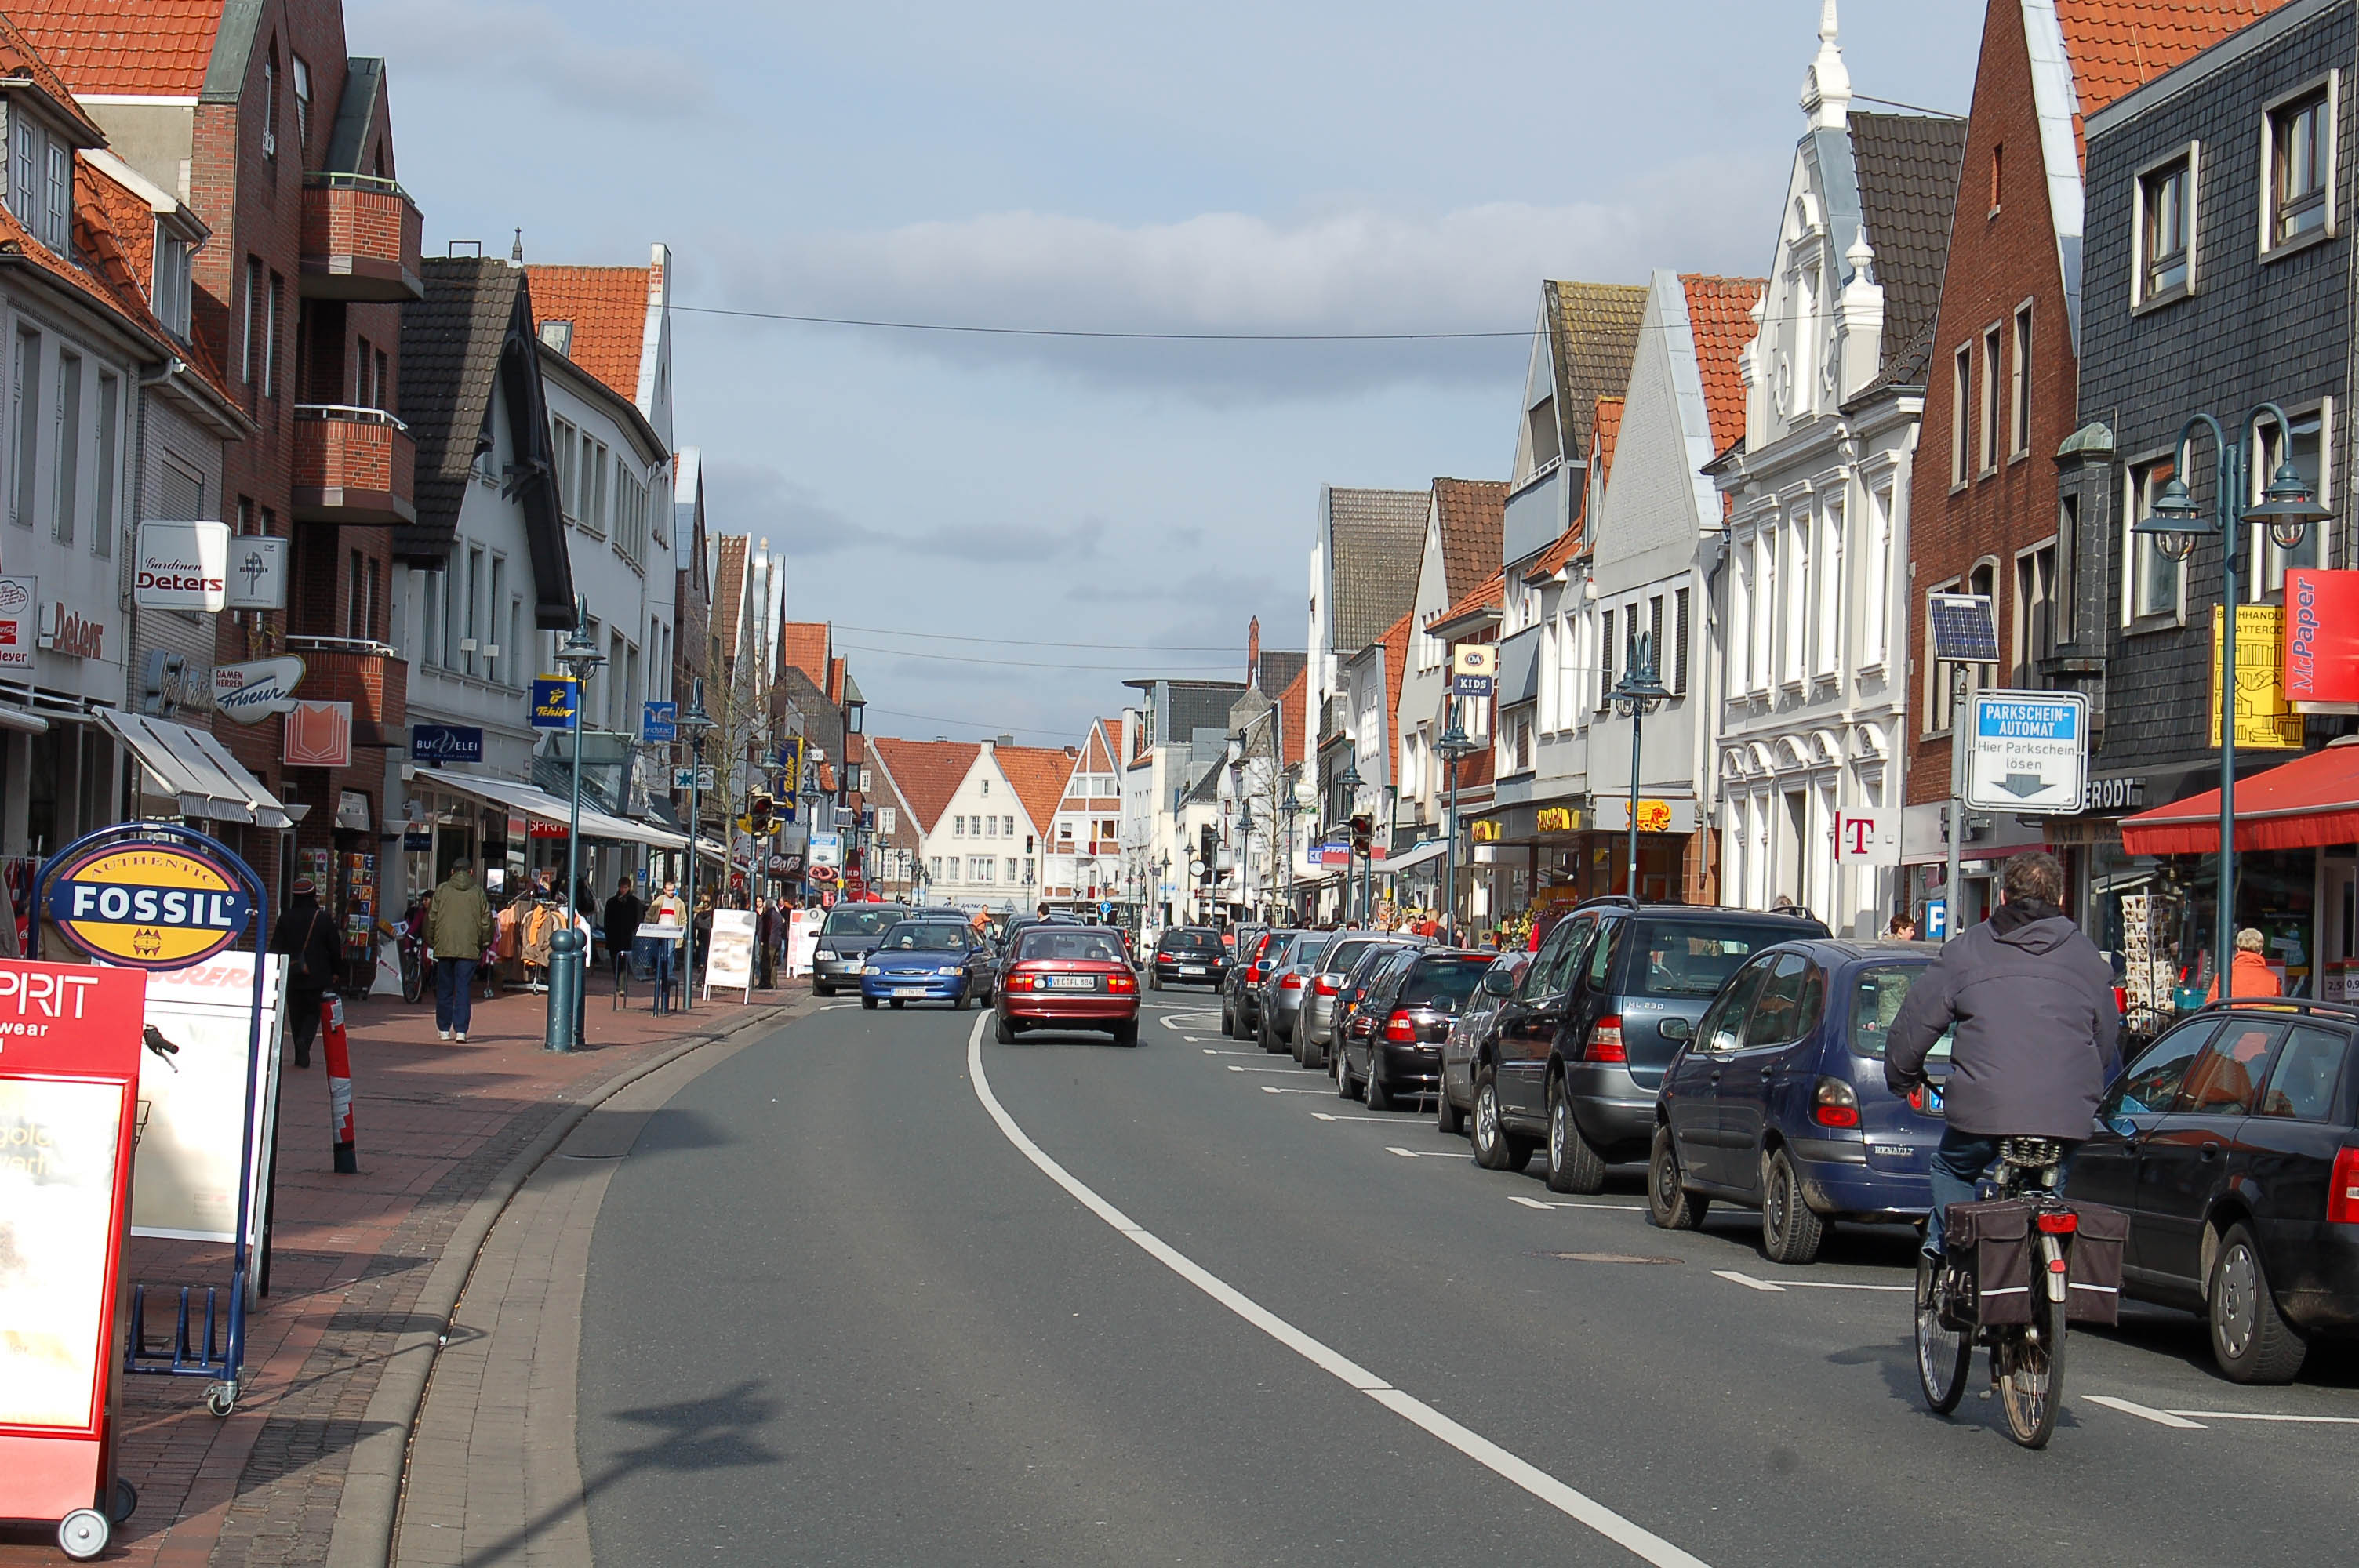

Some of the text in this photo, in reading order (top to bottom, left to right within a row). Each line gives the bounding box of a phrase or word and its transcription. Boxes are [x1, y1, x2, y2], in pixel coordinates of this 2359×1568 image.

[145, 557, 202, 570] Gardinen
[136, 572, 223, 591] Deters
[53, 602, 104, 659] Deters
[2236, 626, 2283, 635] ATTEROD
[2292, 578, 2319, 694] McPaper
[0, 651, 27, 662] eyer
[216, 679, 242, 688] HERREN
[1460, 678, 1487, 689] KIDS
[217, 674, 285, 710] Friseur
[535, 706, 575, 717] Tchibo
[1986, 706, 2070, 721] PARKSCHEIN-
[1999, 721, 2055, 737] AUTOMAT
[1978, 741, 2074, 756] Hier Parkschein
[2007, 757, 2042, 770] lösen
[2085, 778, 2134, 810] ERODT
[1845, 819, 1874, 855] T
[91, 856, 215, 886] AUTHENTIC
[73, 885, 233, 927] FOSSIL
[0, 971, 100, 1020] PRIT
[1874, 1145, 1914, 1155] RENAULT
